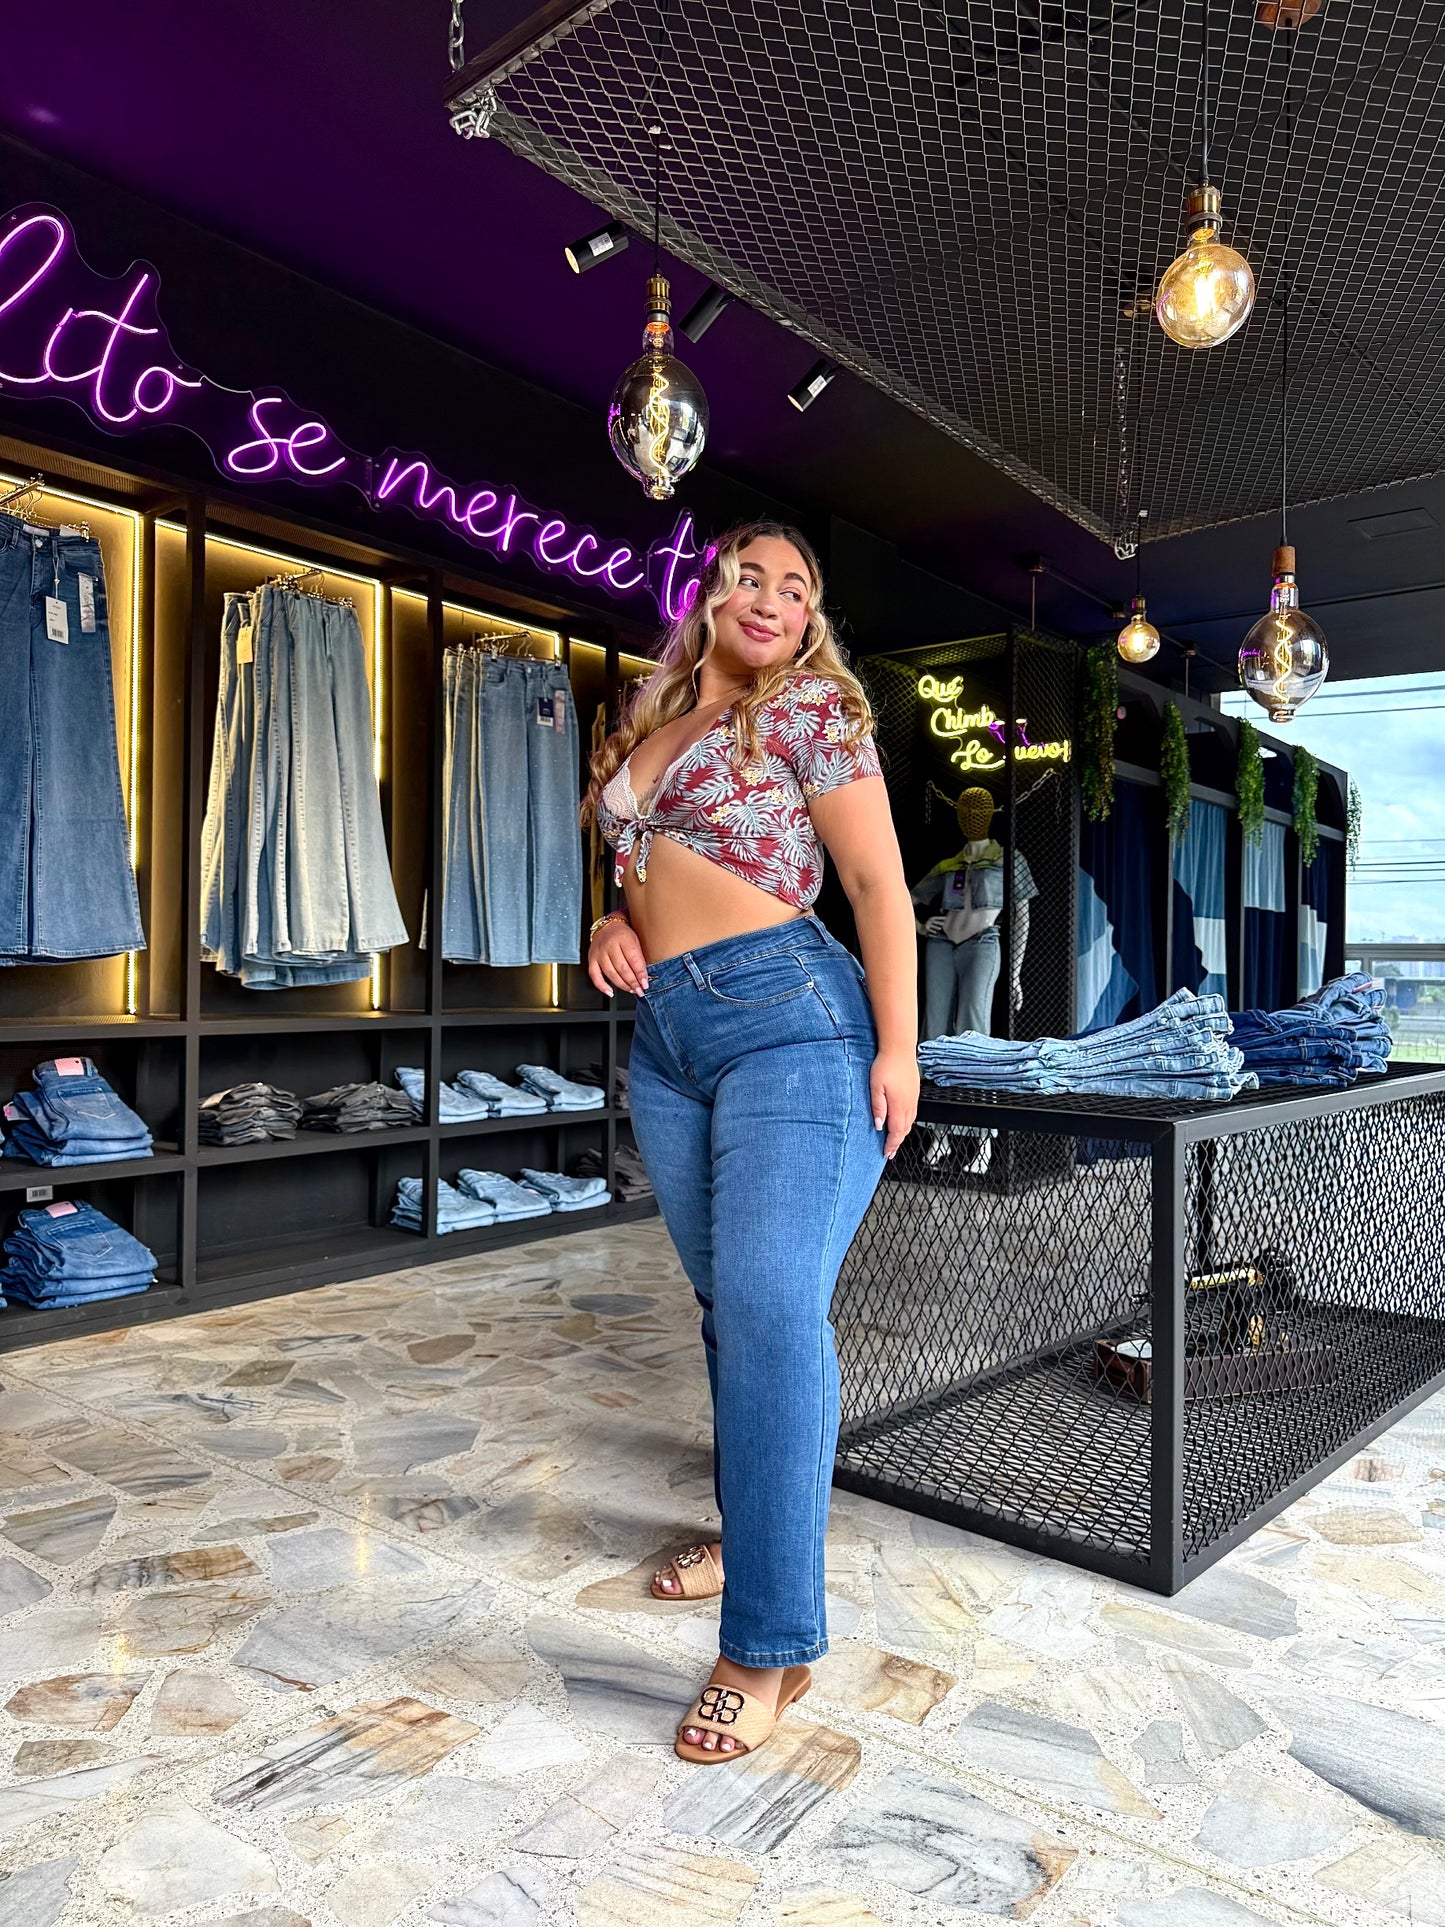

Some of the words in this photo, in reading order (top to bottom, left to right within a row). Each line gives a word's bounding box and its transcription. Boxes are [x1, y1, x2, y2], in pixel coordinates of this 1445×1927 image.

[228, 397, 346, 474] se
[377, 460, 645, 589] merece
[930, 704, 1027, 738] Chimb
[951, 739, 1006, 771] Lo
[1002, 739, 1071, 763] uevo!
